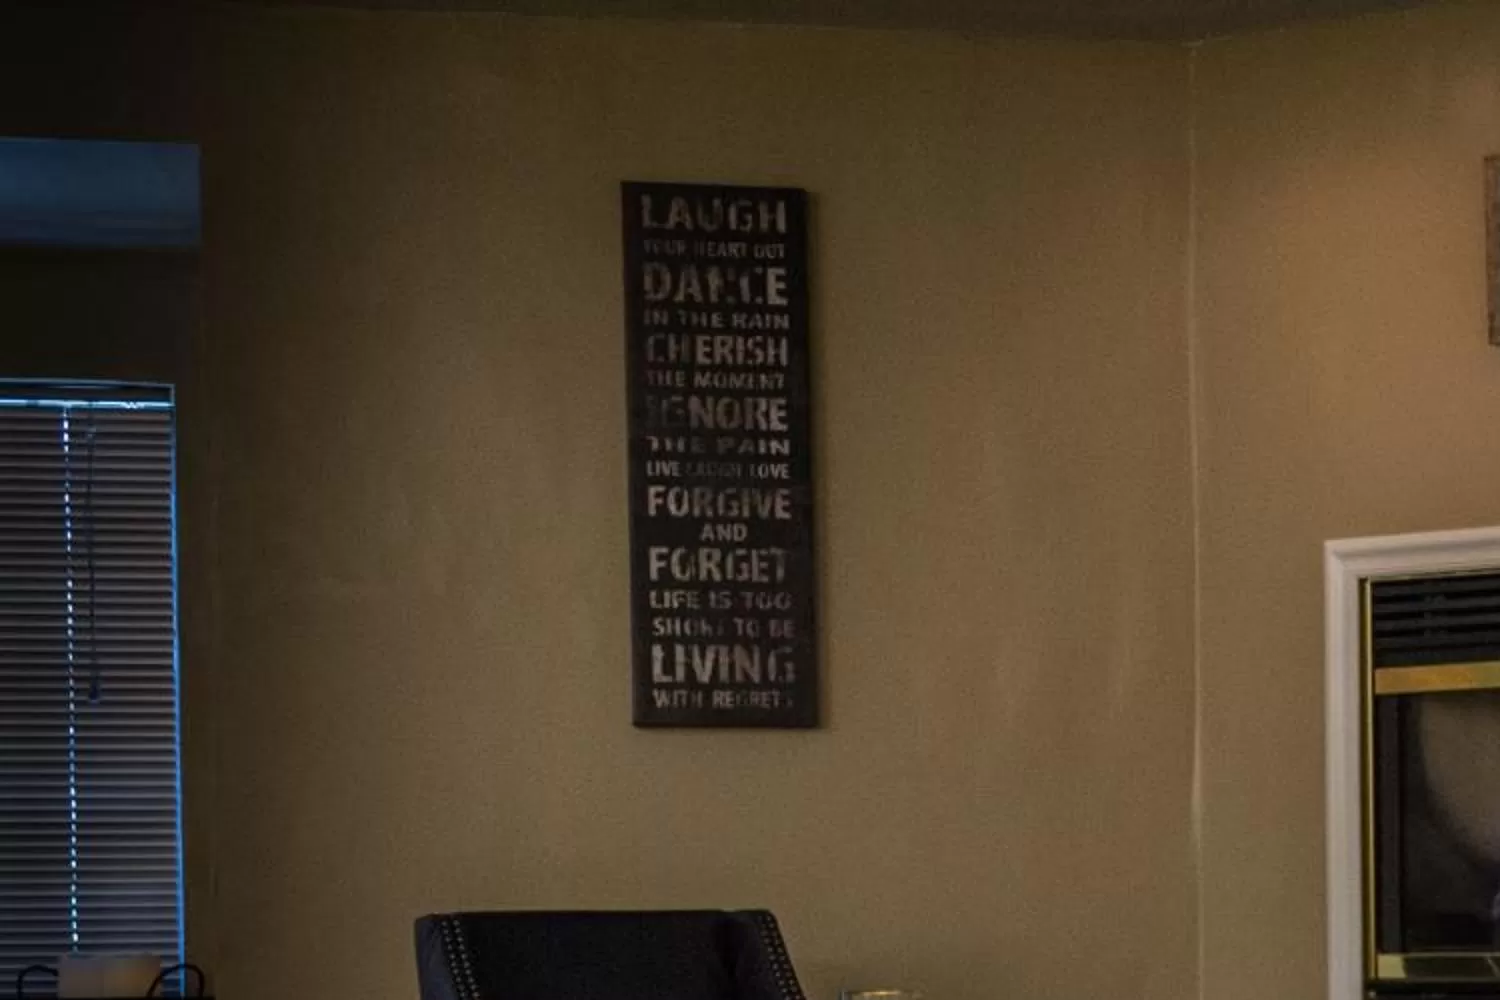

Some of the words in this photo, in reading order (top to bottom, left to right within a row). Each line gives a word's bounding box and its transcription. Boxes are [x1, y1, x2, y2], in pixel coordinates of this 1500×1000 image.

[641, 194, 787, 233] LAUGH
[694, 240, 747, 258] HEART
[753, 243, 785, 259] OUT
[642, 261, 788, 306] DANCE
[643, 309, 668, 325] IN
[678, 310, 724, 328] THE
[731, 312, 790, 329] RAIN
[647, 332, 789, 367] CHERISH
[647, 370, 685, 387] THE
[693, 371, 785, 389] MOMENT
[646, 394, 788, 431] IGNORE
[645, 435, 704, 453] THE
[717, 437, 790, 456] PAIN
[645, 460, 681, 477] LIVE
[750, 462, 791, 480] LOVE
[647, 485, 792, 519] FORGIVE
[700, 522, 748, 542] AND
[648, 545, 787, 583] FORGET
[649, 589, 701, 609] LIFE
[709, 590, 733, 609] IS
[740, 591, 792, 609] TOO
[732, 618, 760, 637] TO
[769, 619, 795, 638] BE
[652, 643, 796, 685] LIVING
[652, 689, 703, 709] WITH
